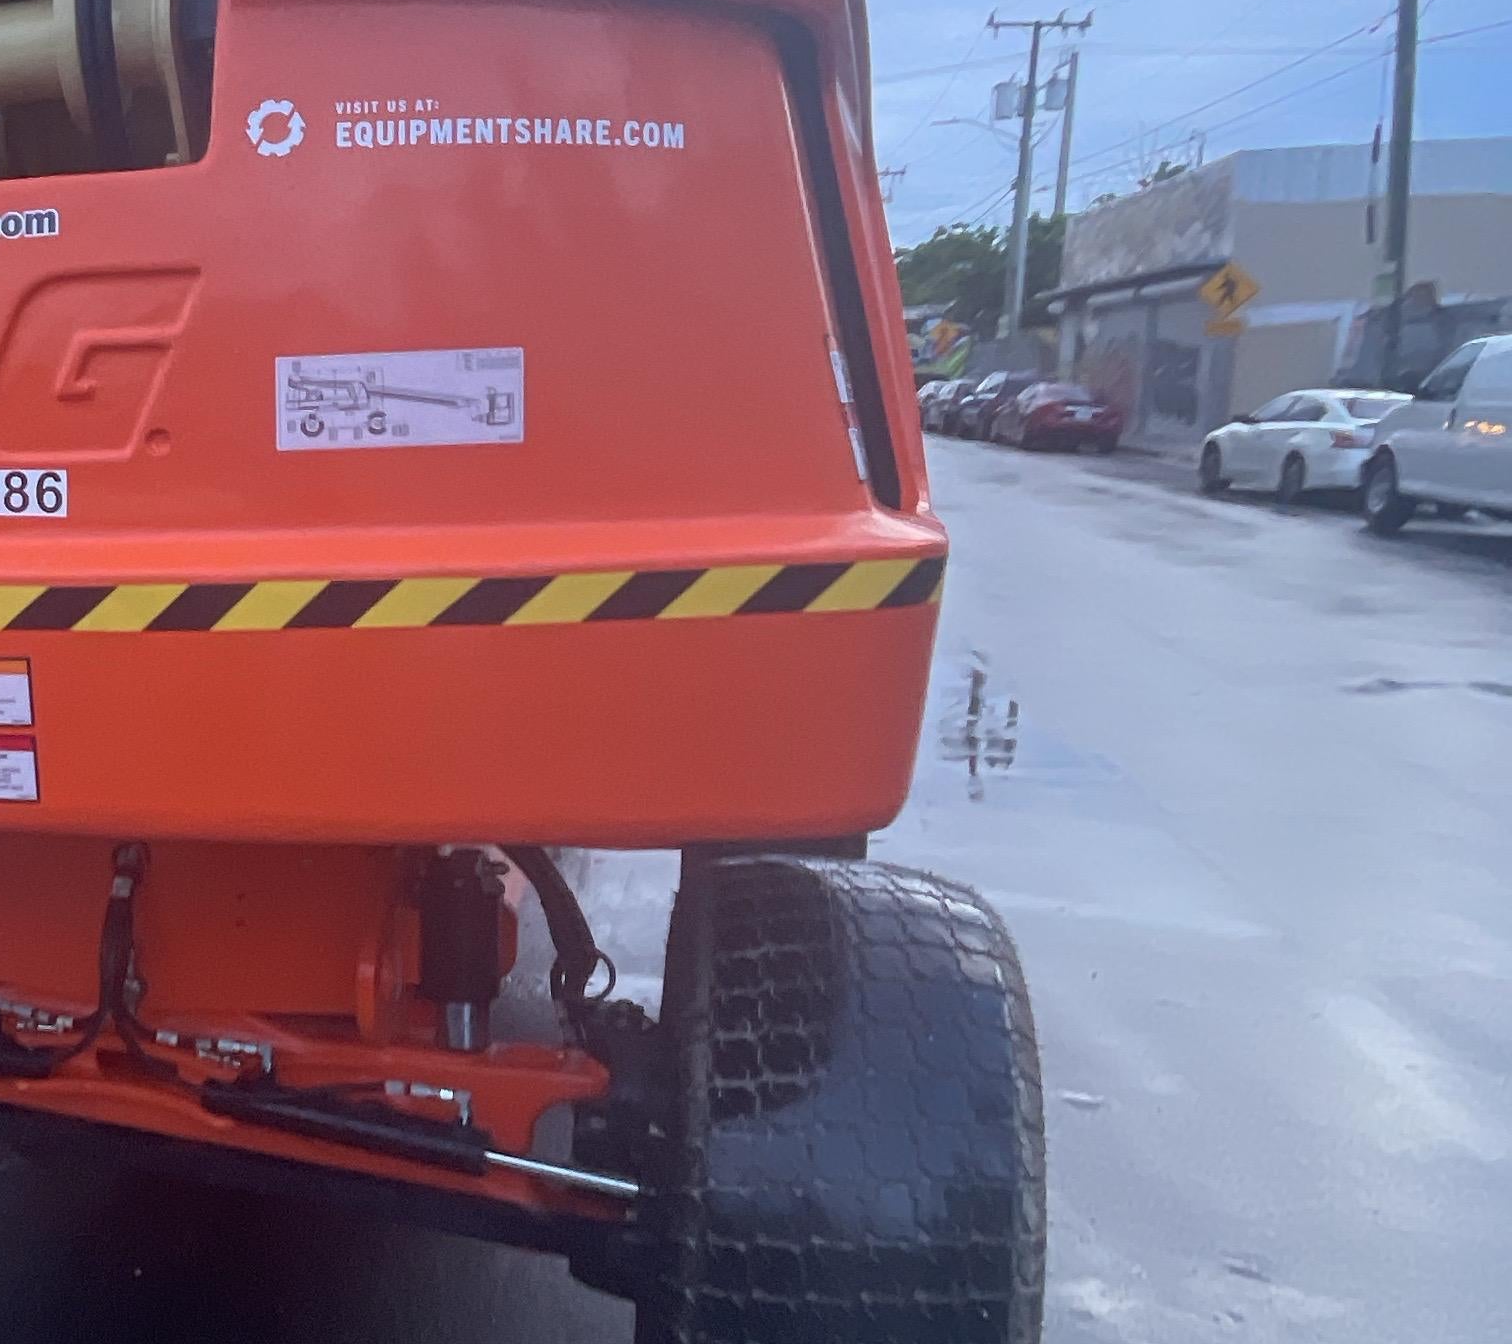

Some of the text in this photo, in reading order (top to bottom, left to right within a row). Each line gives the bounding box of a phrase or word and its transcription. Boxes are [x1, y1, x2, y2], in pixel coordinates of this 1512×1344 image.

[336, 100, 379, 114] VISIT
[387, 100, 407, 113] US
[335, 118, 685, 149] EQUIPMENTSHARE.COM
